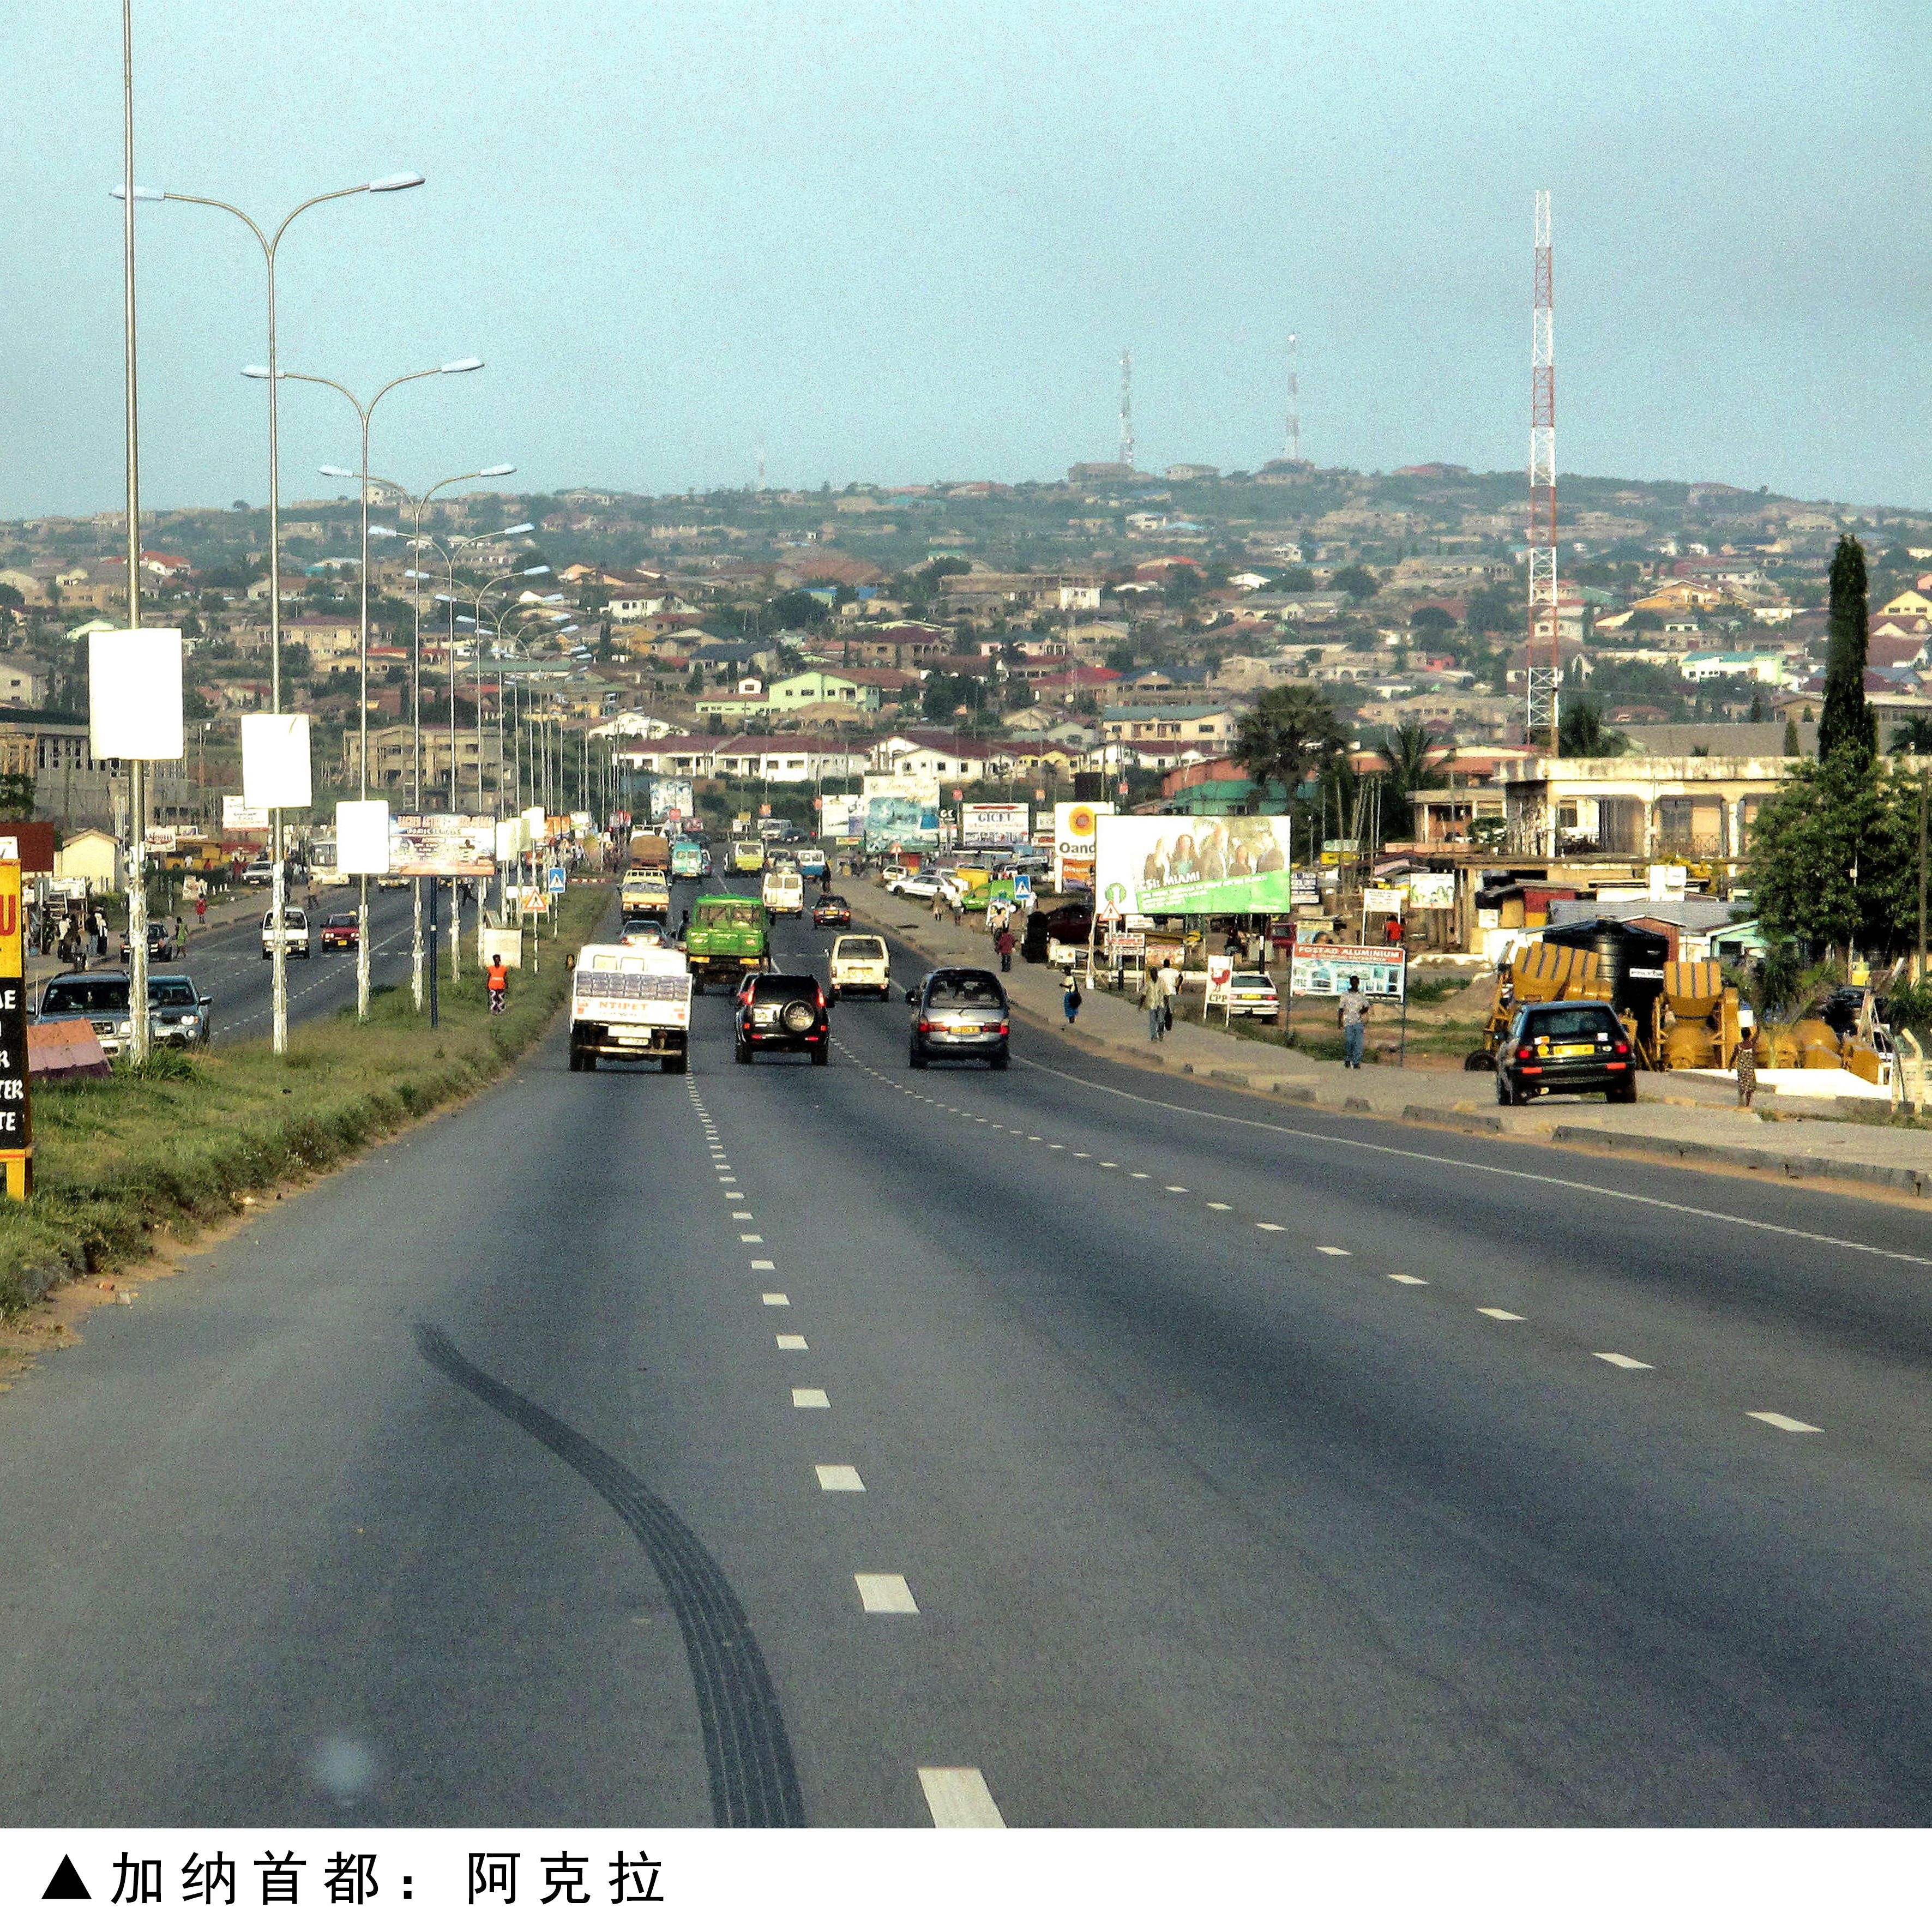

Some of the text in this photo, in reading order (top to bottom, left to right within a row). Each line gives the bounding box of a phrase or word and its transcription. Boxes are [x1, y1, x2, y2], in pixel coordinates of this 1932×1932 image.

[1164, 871, 1200, 886] MIAMI
[1341, 948, 1400, 958] ALUMINIUM
[1208, 994, 1227, 1002] CPP
